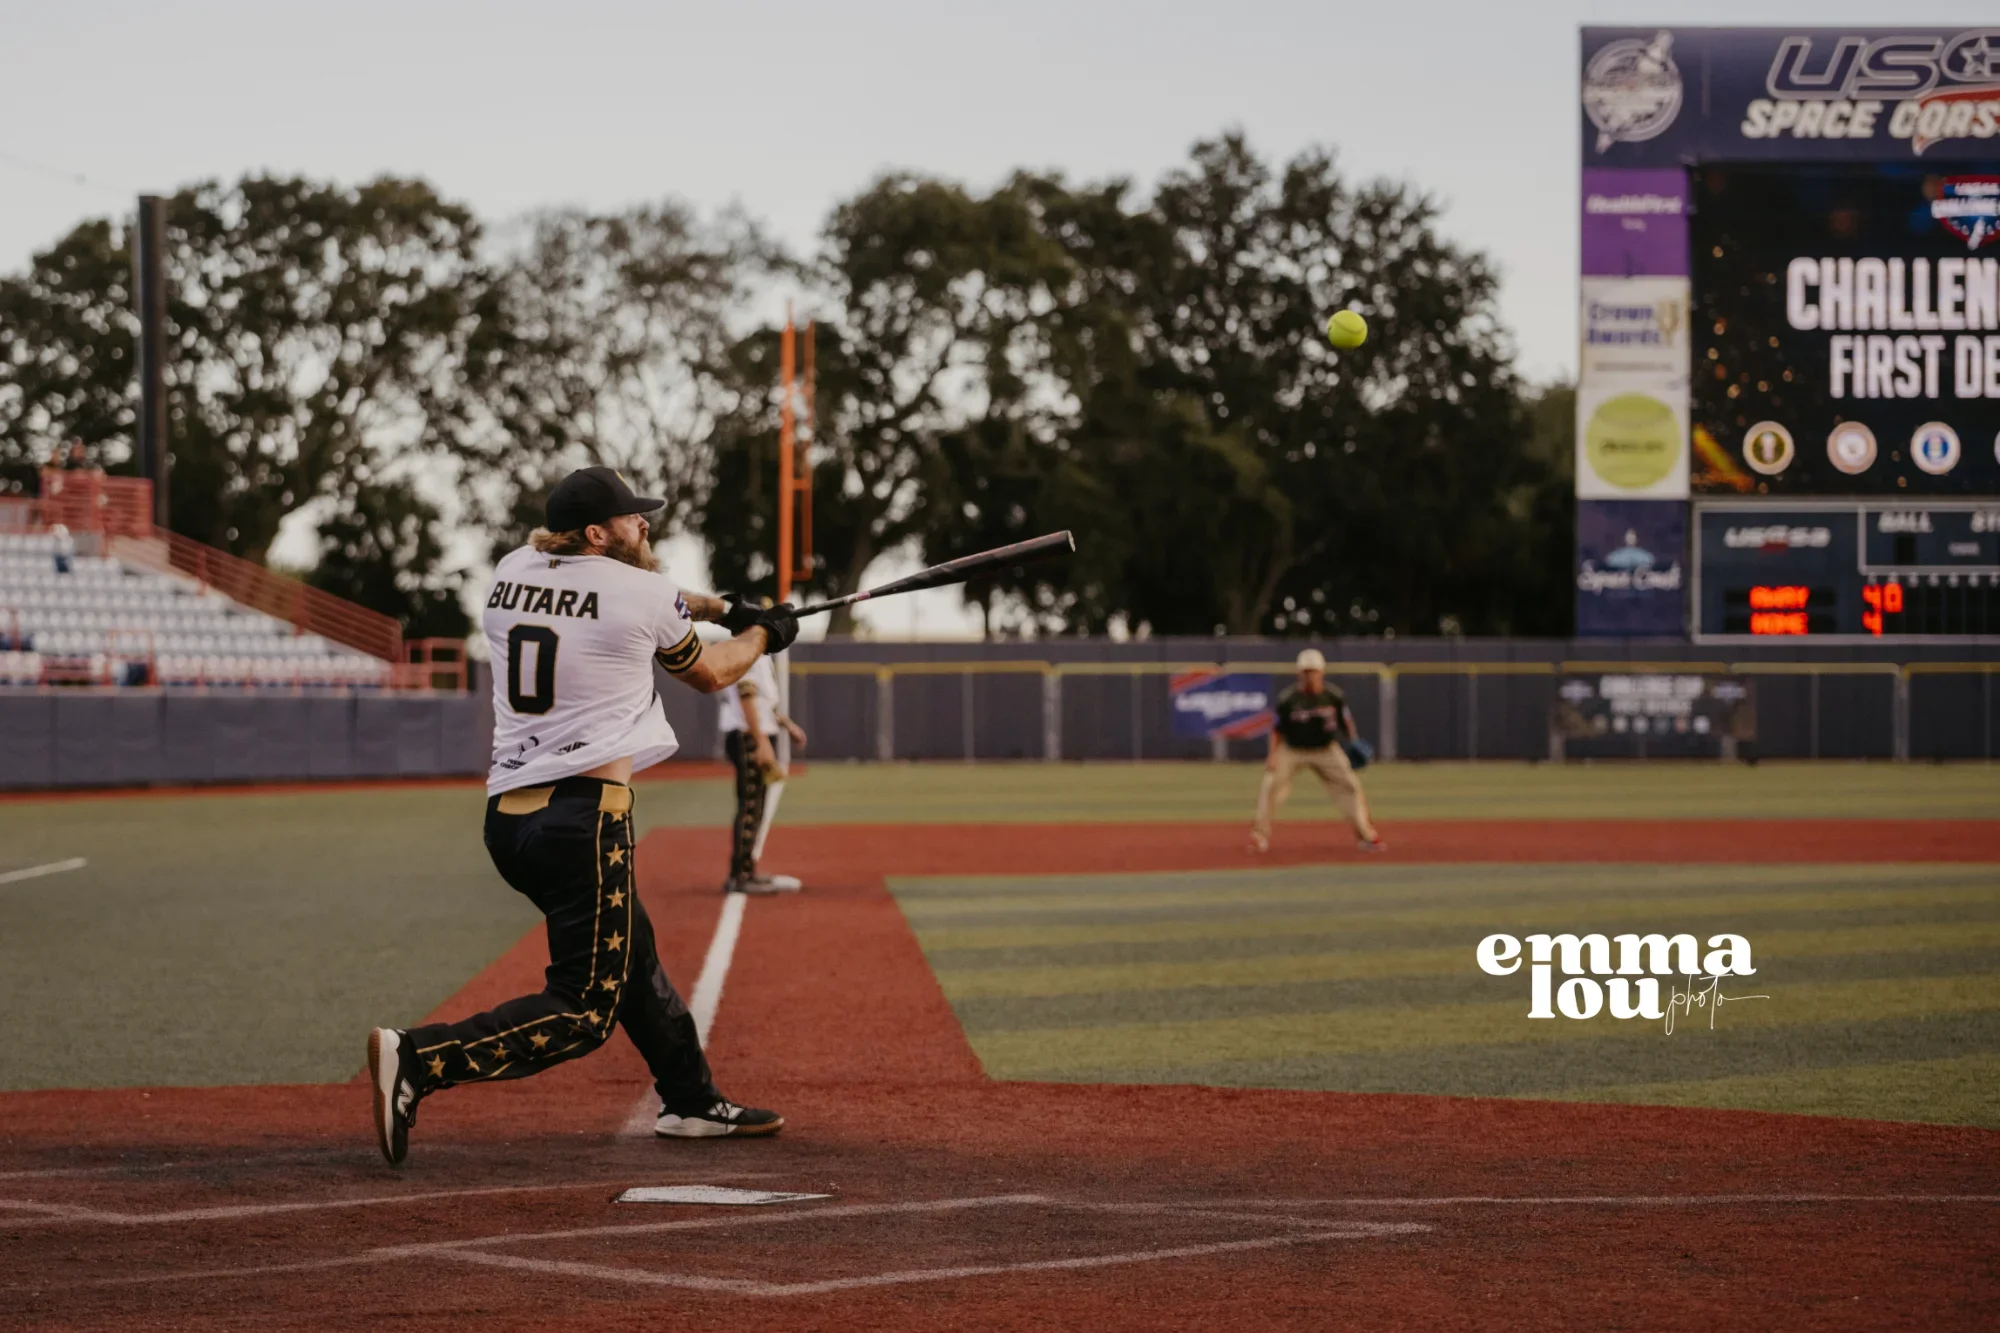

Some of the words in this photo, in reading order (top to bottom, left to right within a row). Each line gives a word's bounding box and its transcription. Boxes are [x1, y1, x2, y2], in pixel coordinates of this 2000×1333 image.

[1741, 99, 1883, 139] SPACE
[1830, 334, 1946, 399] FIRST
[1955, 334, 2000, 399] DE
[487, 581, 599, 620] BUTARA
[507, 622, 560, 716] 0
